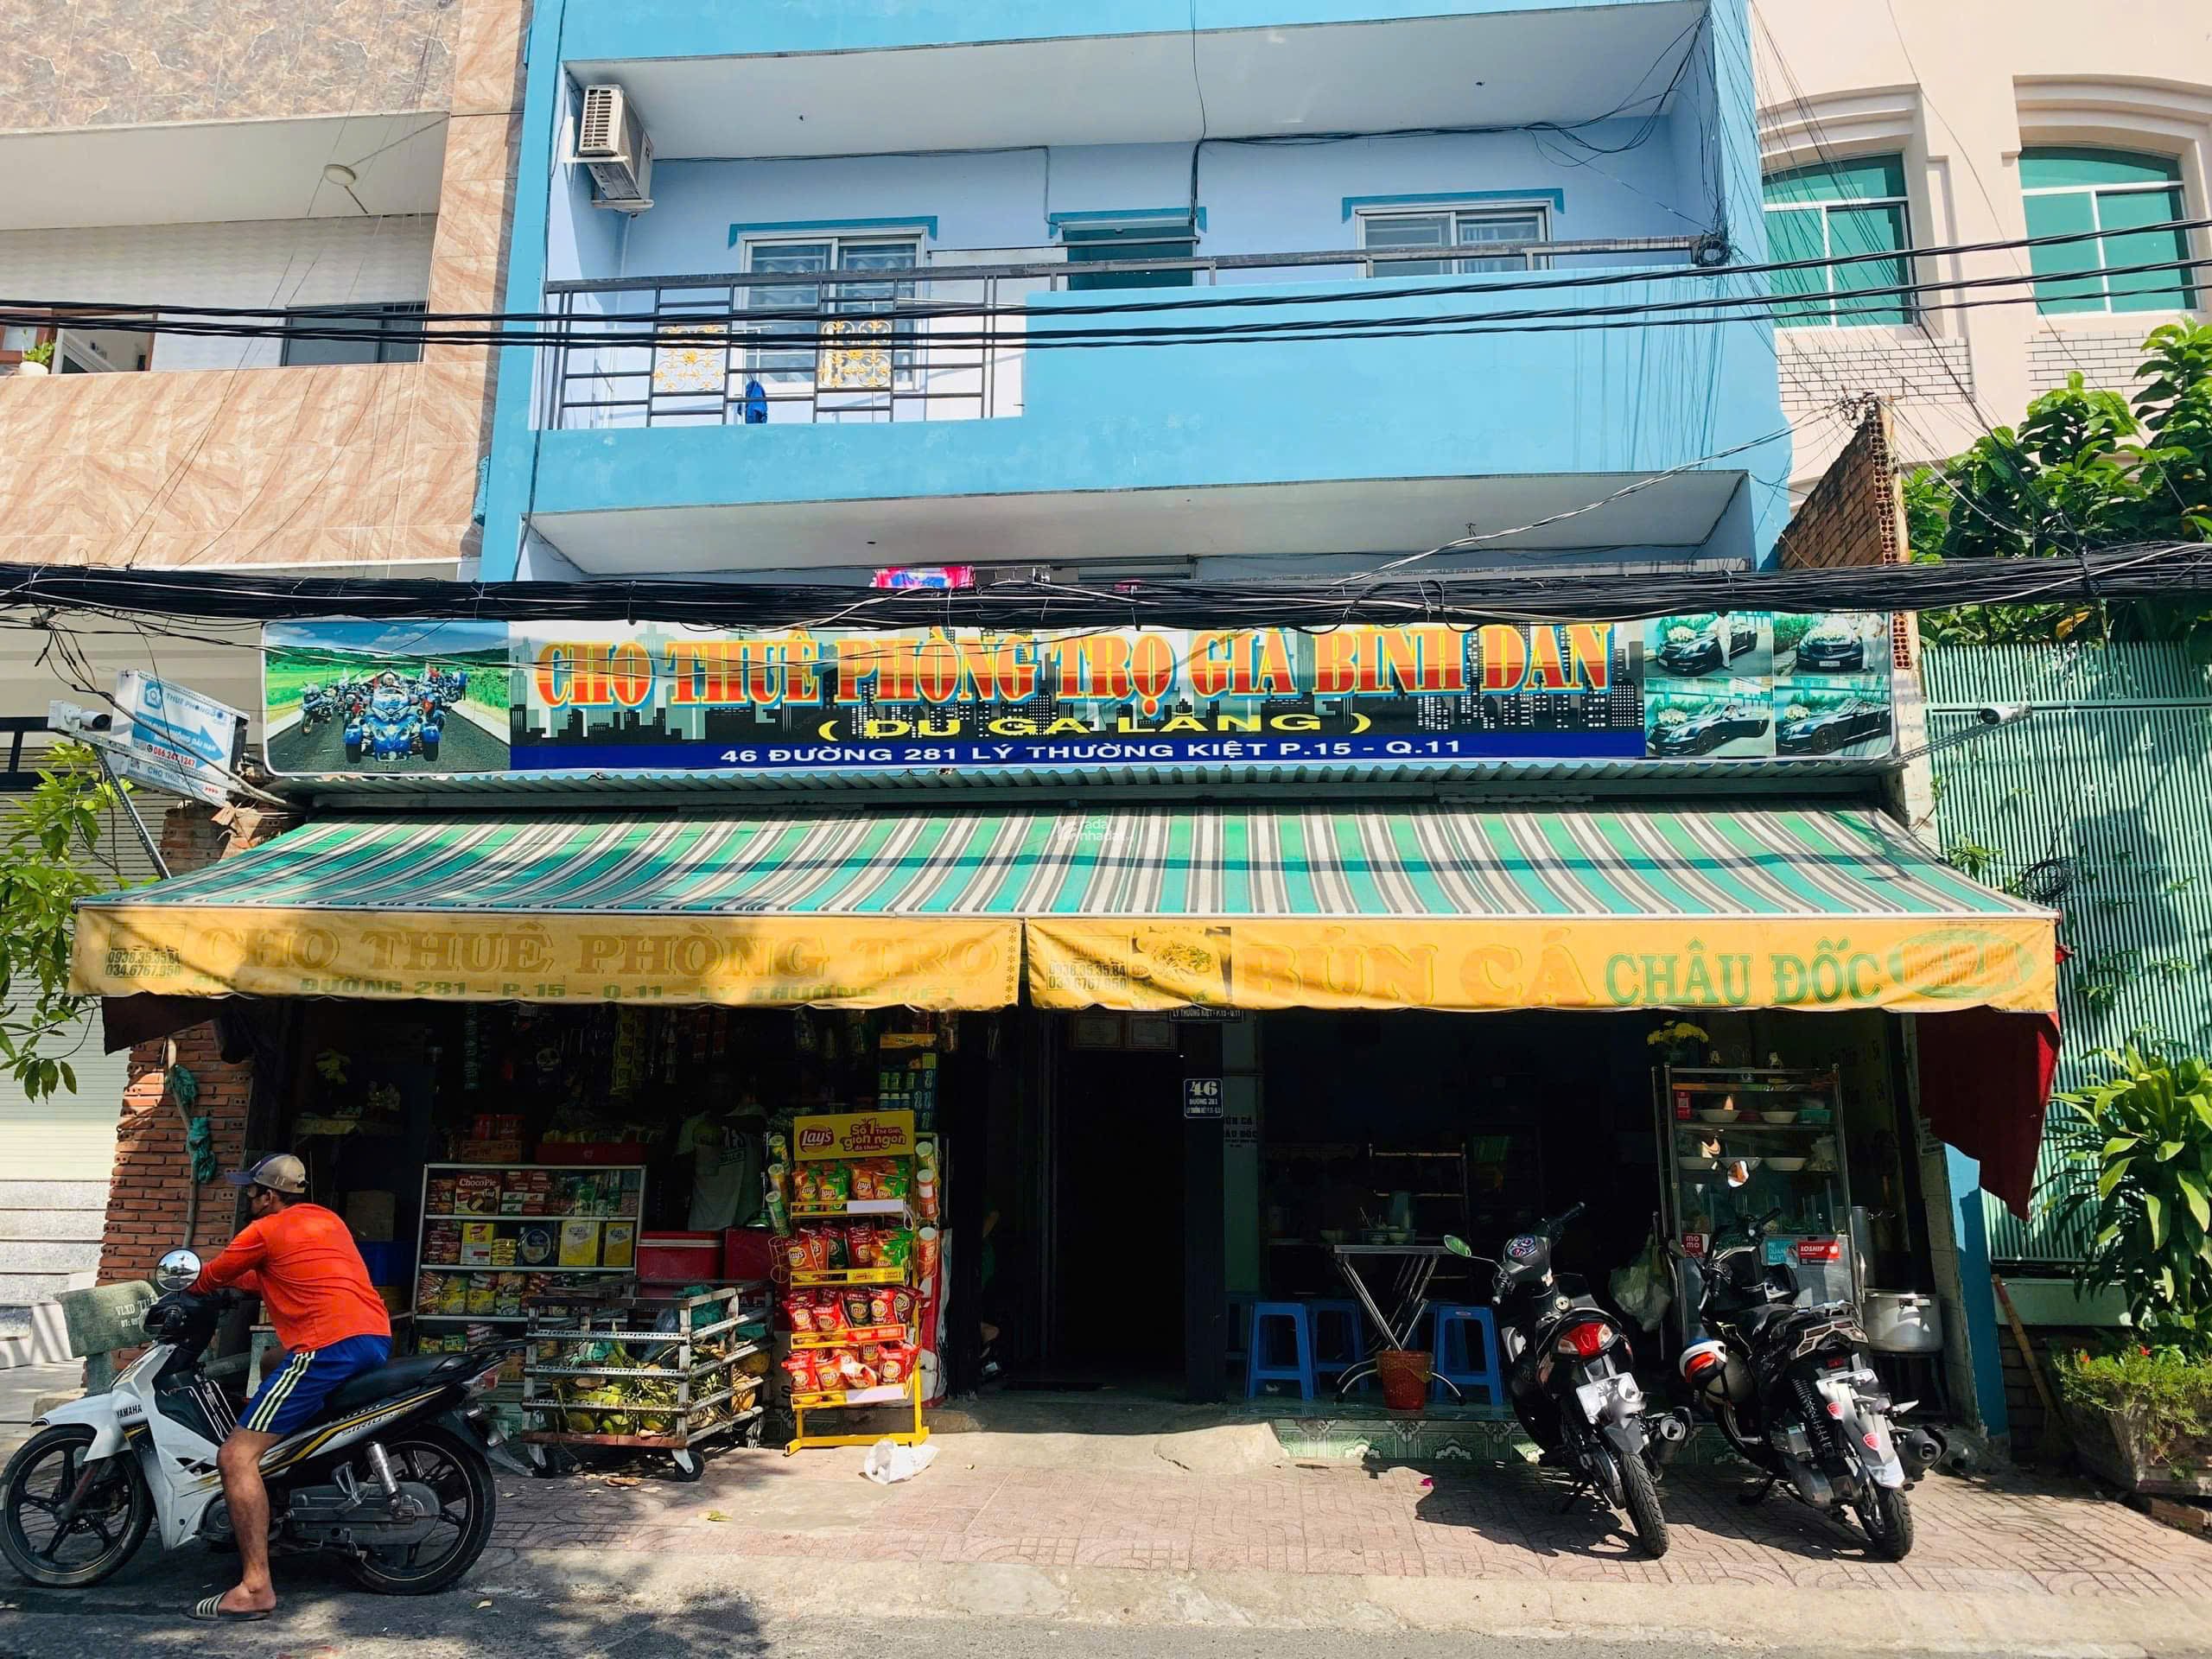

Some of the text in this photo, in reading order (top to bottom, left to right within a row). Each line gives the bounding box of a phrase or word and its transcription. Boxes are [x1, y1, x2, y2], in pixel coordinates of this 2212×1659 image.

[536, 642, 655, 709] CHO
[664, 627, 821, 705] THUÊ
[834, 626, 1039, 704] PHÒNG
[1051, 632, 1176, 717] TRỌ
[988, 716, 1090, 736] GA
[1117, 710, 1321, 734] LĂNG
[721, 749, 757, 762] 46
[769, 746, 892, 761] ĐƯỜNG
[904, 747, 956, 760] 281
[972, 743, 1015, 760] LÝ
[1027, 741, 1174, 759] THƯỜNG
[1187, 740, 1268, 759] KIỆT
[1280, 741, 1351, 755] P.15
[1386, 740, 1459, 755] Q.11
[199, 927, 340, 969] CHO
[359, 924, 556, 974] THUÊ
[575, 923, 830, 977] PHÒNG
[1244, 926, 1439, 1005] BÚN
[1460, 927, 1597, 1005] CÁ
[1604, 936, 1752, 1006] CHÂU
[1770, 935, 1885, 1005] ĐỐC
[415, 981, 467, 995] 281
[502, 982, 566, 997] P.15
[604, 984, 664, 1000] Q.11
[1189, 1081, 1217, 1096] 46
[116, 1403, 143, 1419] YAMAHA
